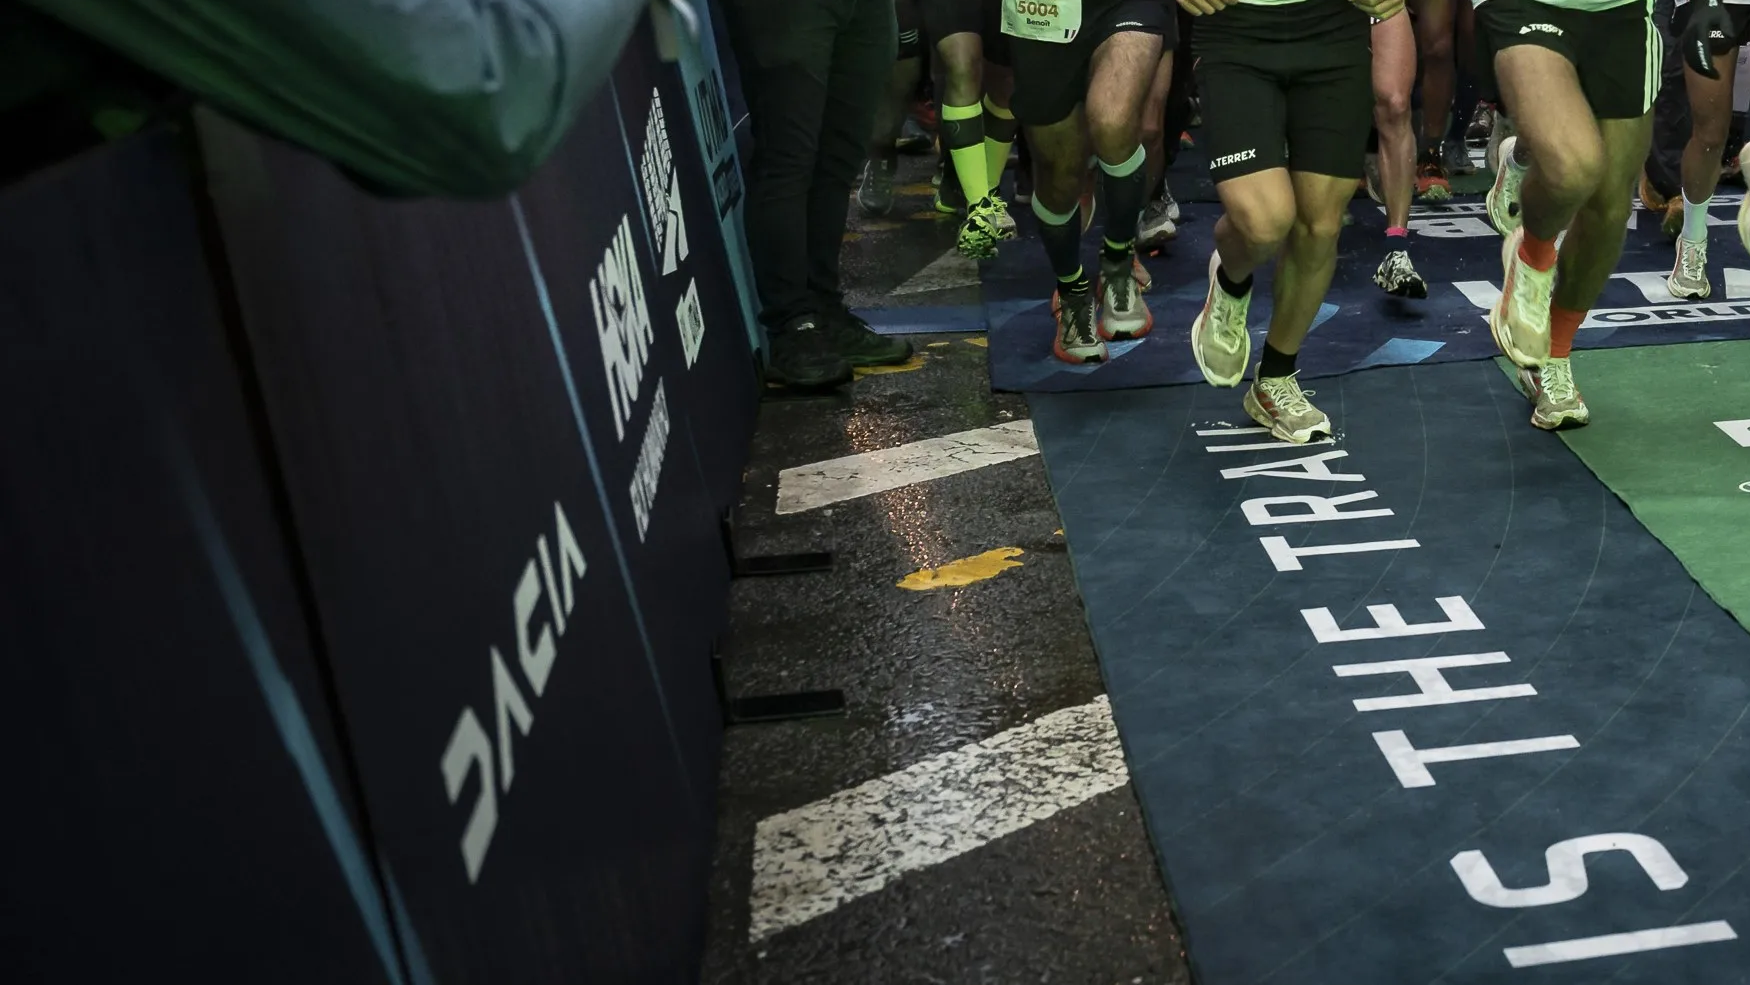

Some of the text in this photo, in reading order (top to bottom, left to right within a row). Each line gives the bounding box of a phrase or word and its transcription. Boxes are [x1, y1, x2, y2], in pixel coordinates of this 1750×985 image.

[1017, 0, 1059, 18] 5004
[1026, 17, 1051, 27] Benoît
[1215, 148, 1257, 167] TERREX
[1300, 595, 1580, 788] THE
[1450, 831, 1738, 968] IS
